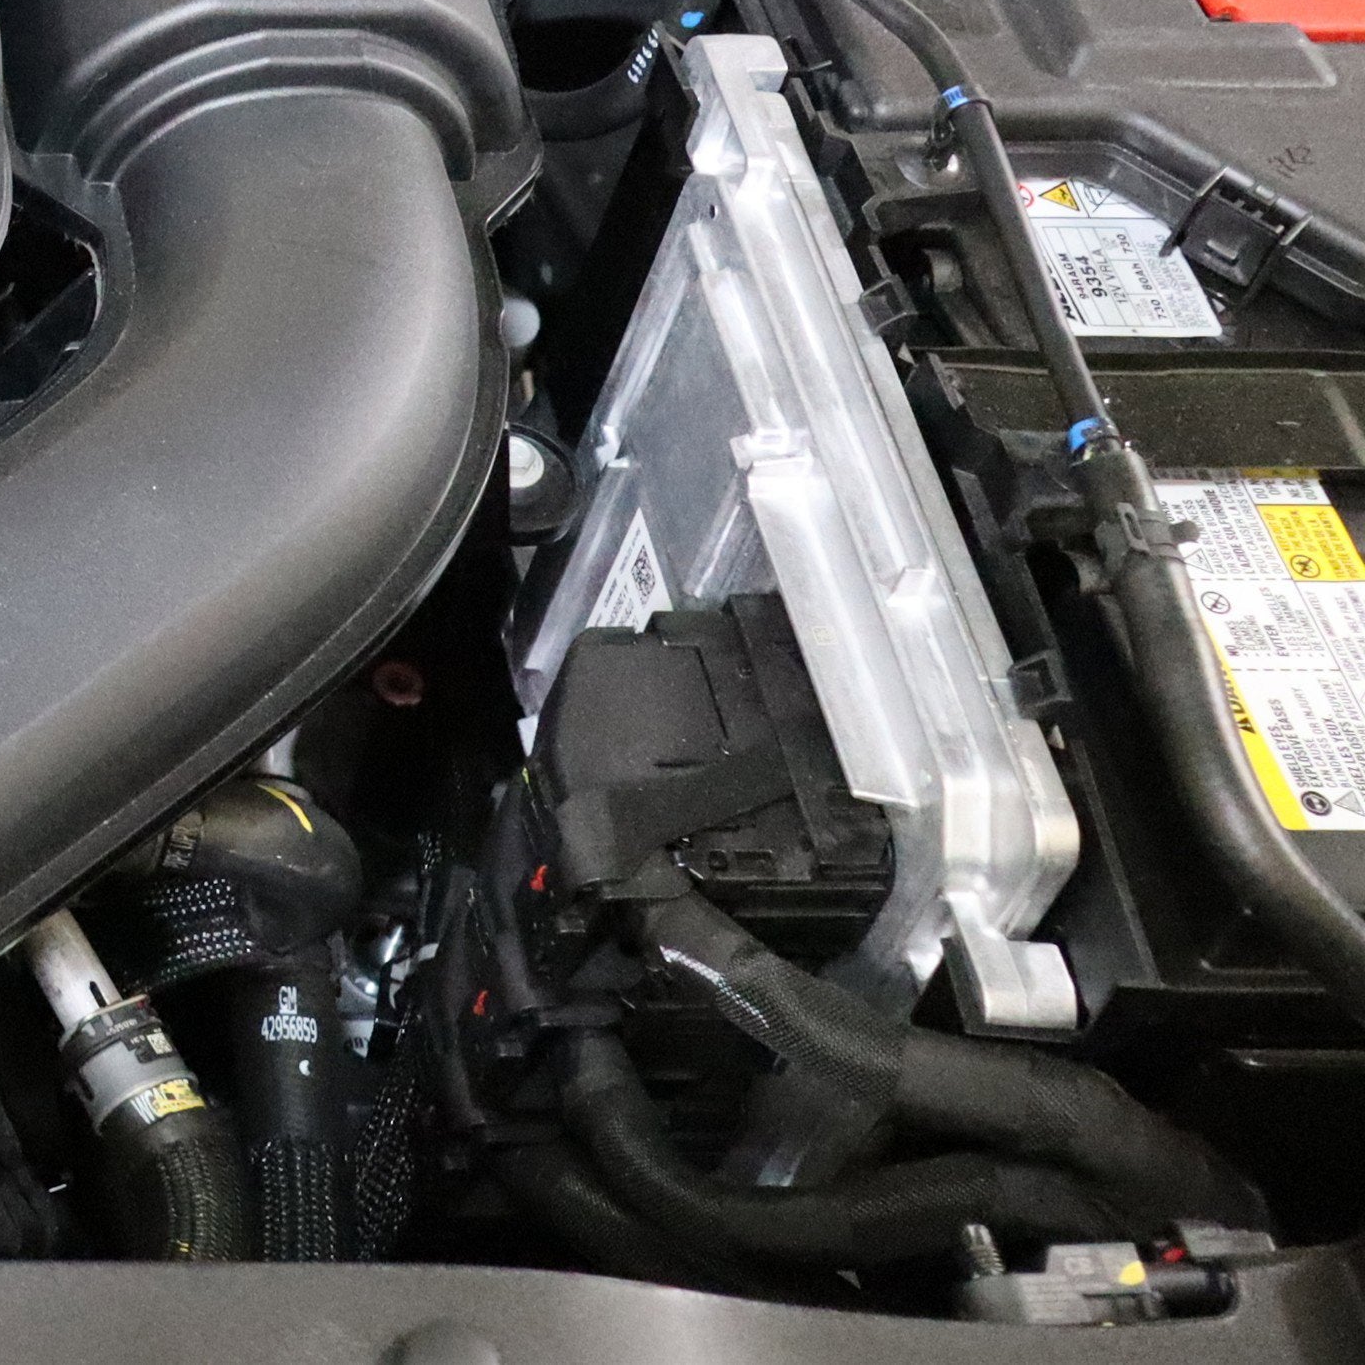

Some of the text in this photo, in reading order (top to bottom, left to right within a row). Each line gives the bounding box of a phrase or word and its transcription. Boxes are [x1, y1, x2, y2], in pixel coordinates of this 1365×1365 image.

[1116, 233, 1133, 253] 730
[1058, 253, 1089, 299] 94RAGM
[1074, 255, 1108, 296] 9354
[1091, 248, 1116, 280] VRLA
[1131, 263, 1152, 289] 80Ah
[1109, 284, 1128, 303] 12V
[1150, 299, 1167, 319] 730
[1268, 699, 1322, 787] EXPLOSIVE GASES
[1338, 746, 1355, 763] LES
[1282, 754, 1309, 787] SHIELD
[1304, 739, 1336, 787] CAN CAUSE
[1317, 737, 1351, 787] BLINDNESS
[279, 985, 298, 1014] GM
[261, 1016, 318, 1043] 42956859
